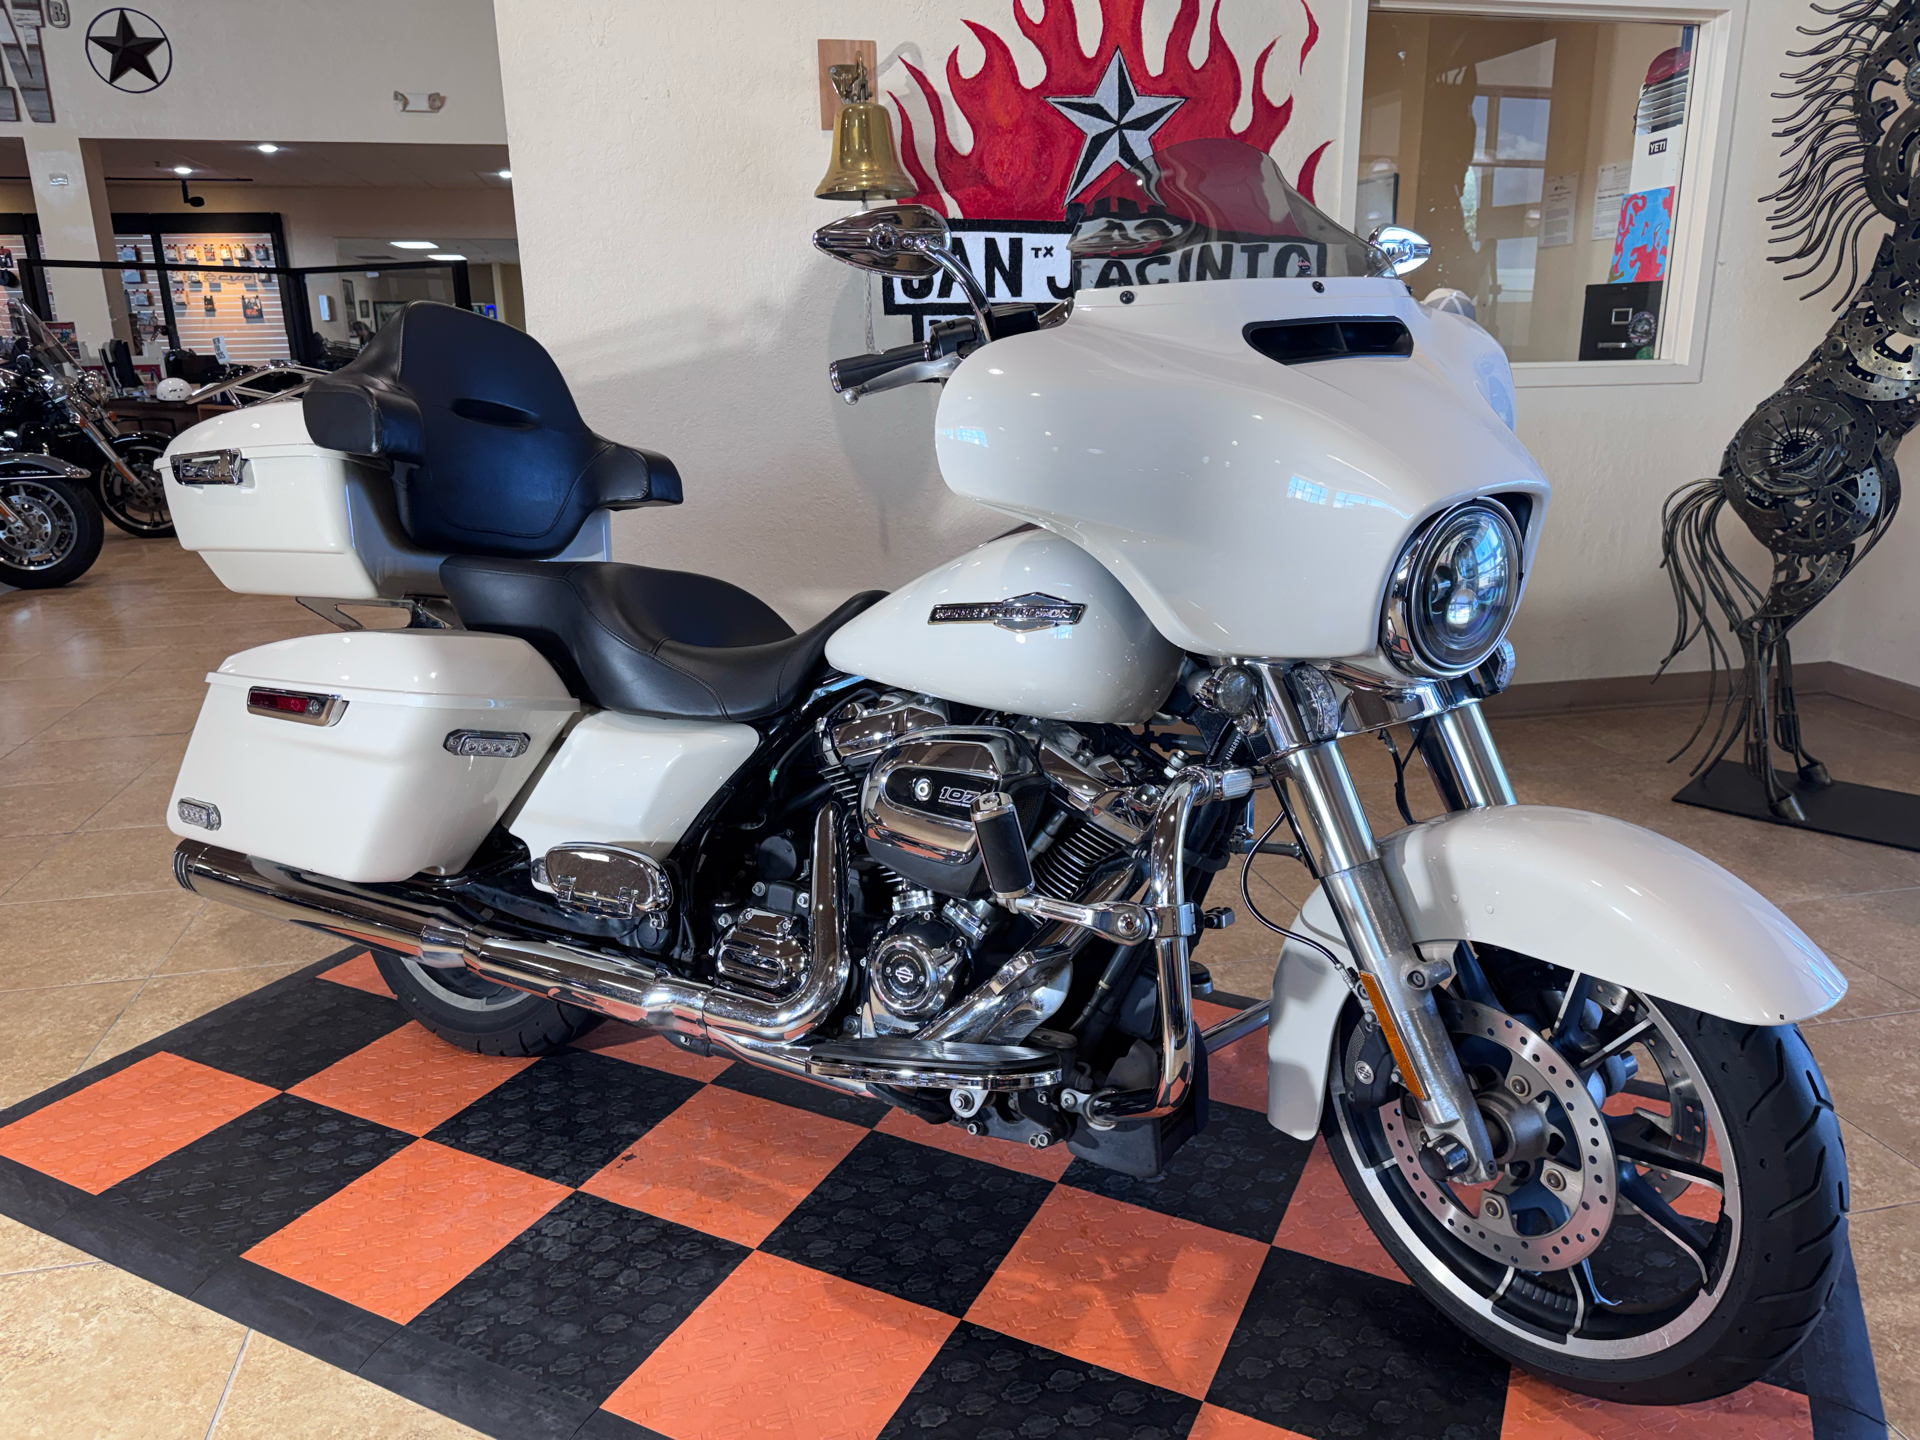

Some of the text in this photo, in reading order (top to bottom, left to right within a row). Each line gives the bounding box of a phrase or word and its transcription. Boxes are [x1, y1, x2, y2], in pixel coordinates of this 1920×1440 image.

[1650, 141, 1666, 154] YETI
[1031, 245, 1054, 259] TX
[218, 274, 252, 282] CVO
[939, 786, 981, 804] 107
